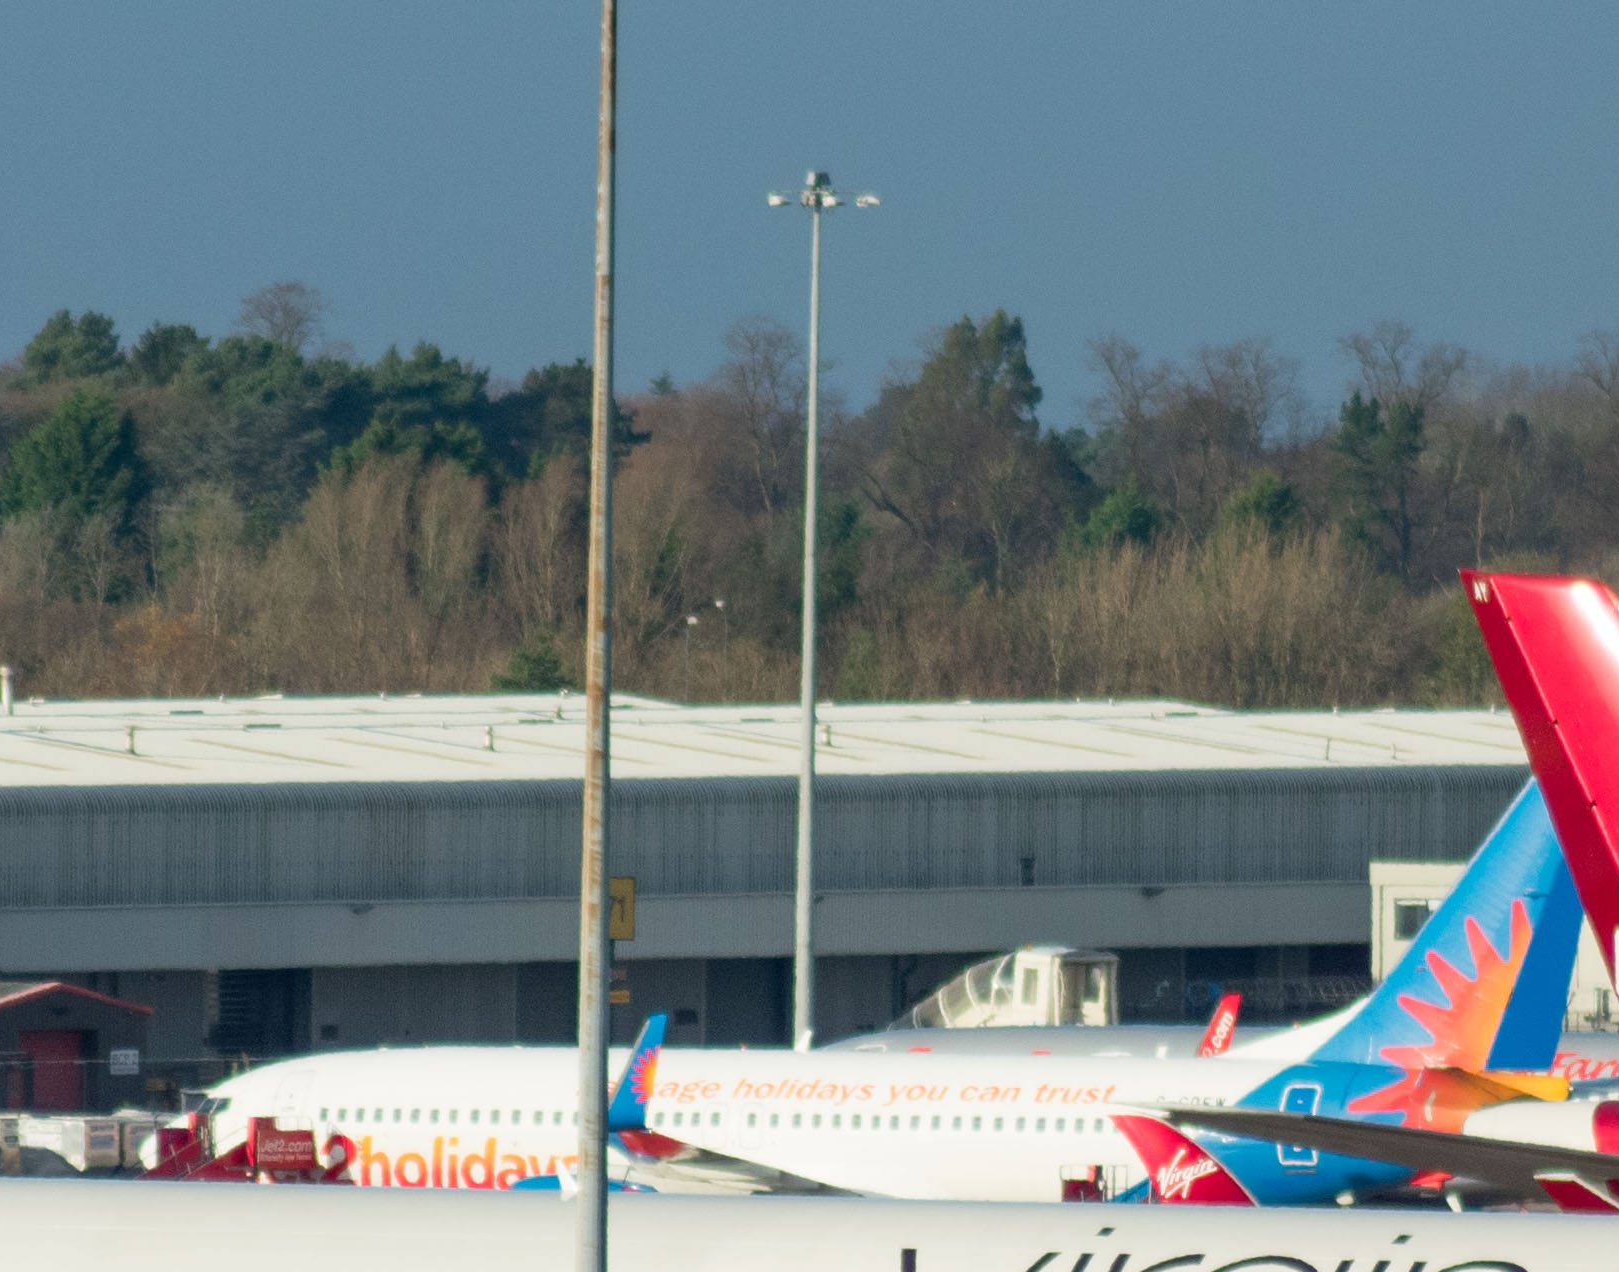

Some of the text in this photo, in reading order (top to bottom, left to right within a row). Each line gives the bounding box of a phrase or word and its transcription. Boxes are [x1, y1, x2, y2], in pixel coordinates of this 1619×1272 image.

[733, 1077, 875, 1106] holidays
[882, 1083, 950, 1107] you
[959, 1084, 1021, 1103] can
[1033, 1083, 1117, 1105] trust
[1156, 1149, 1218, 1199] Virgin
